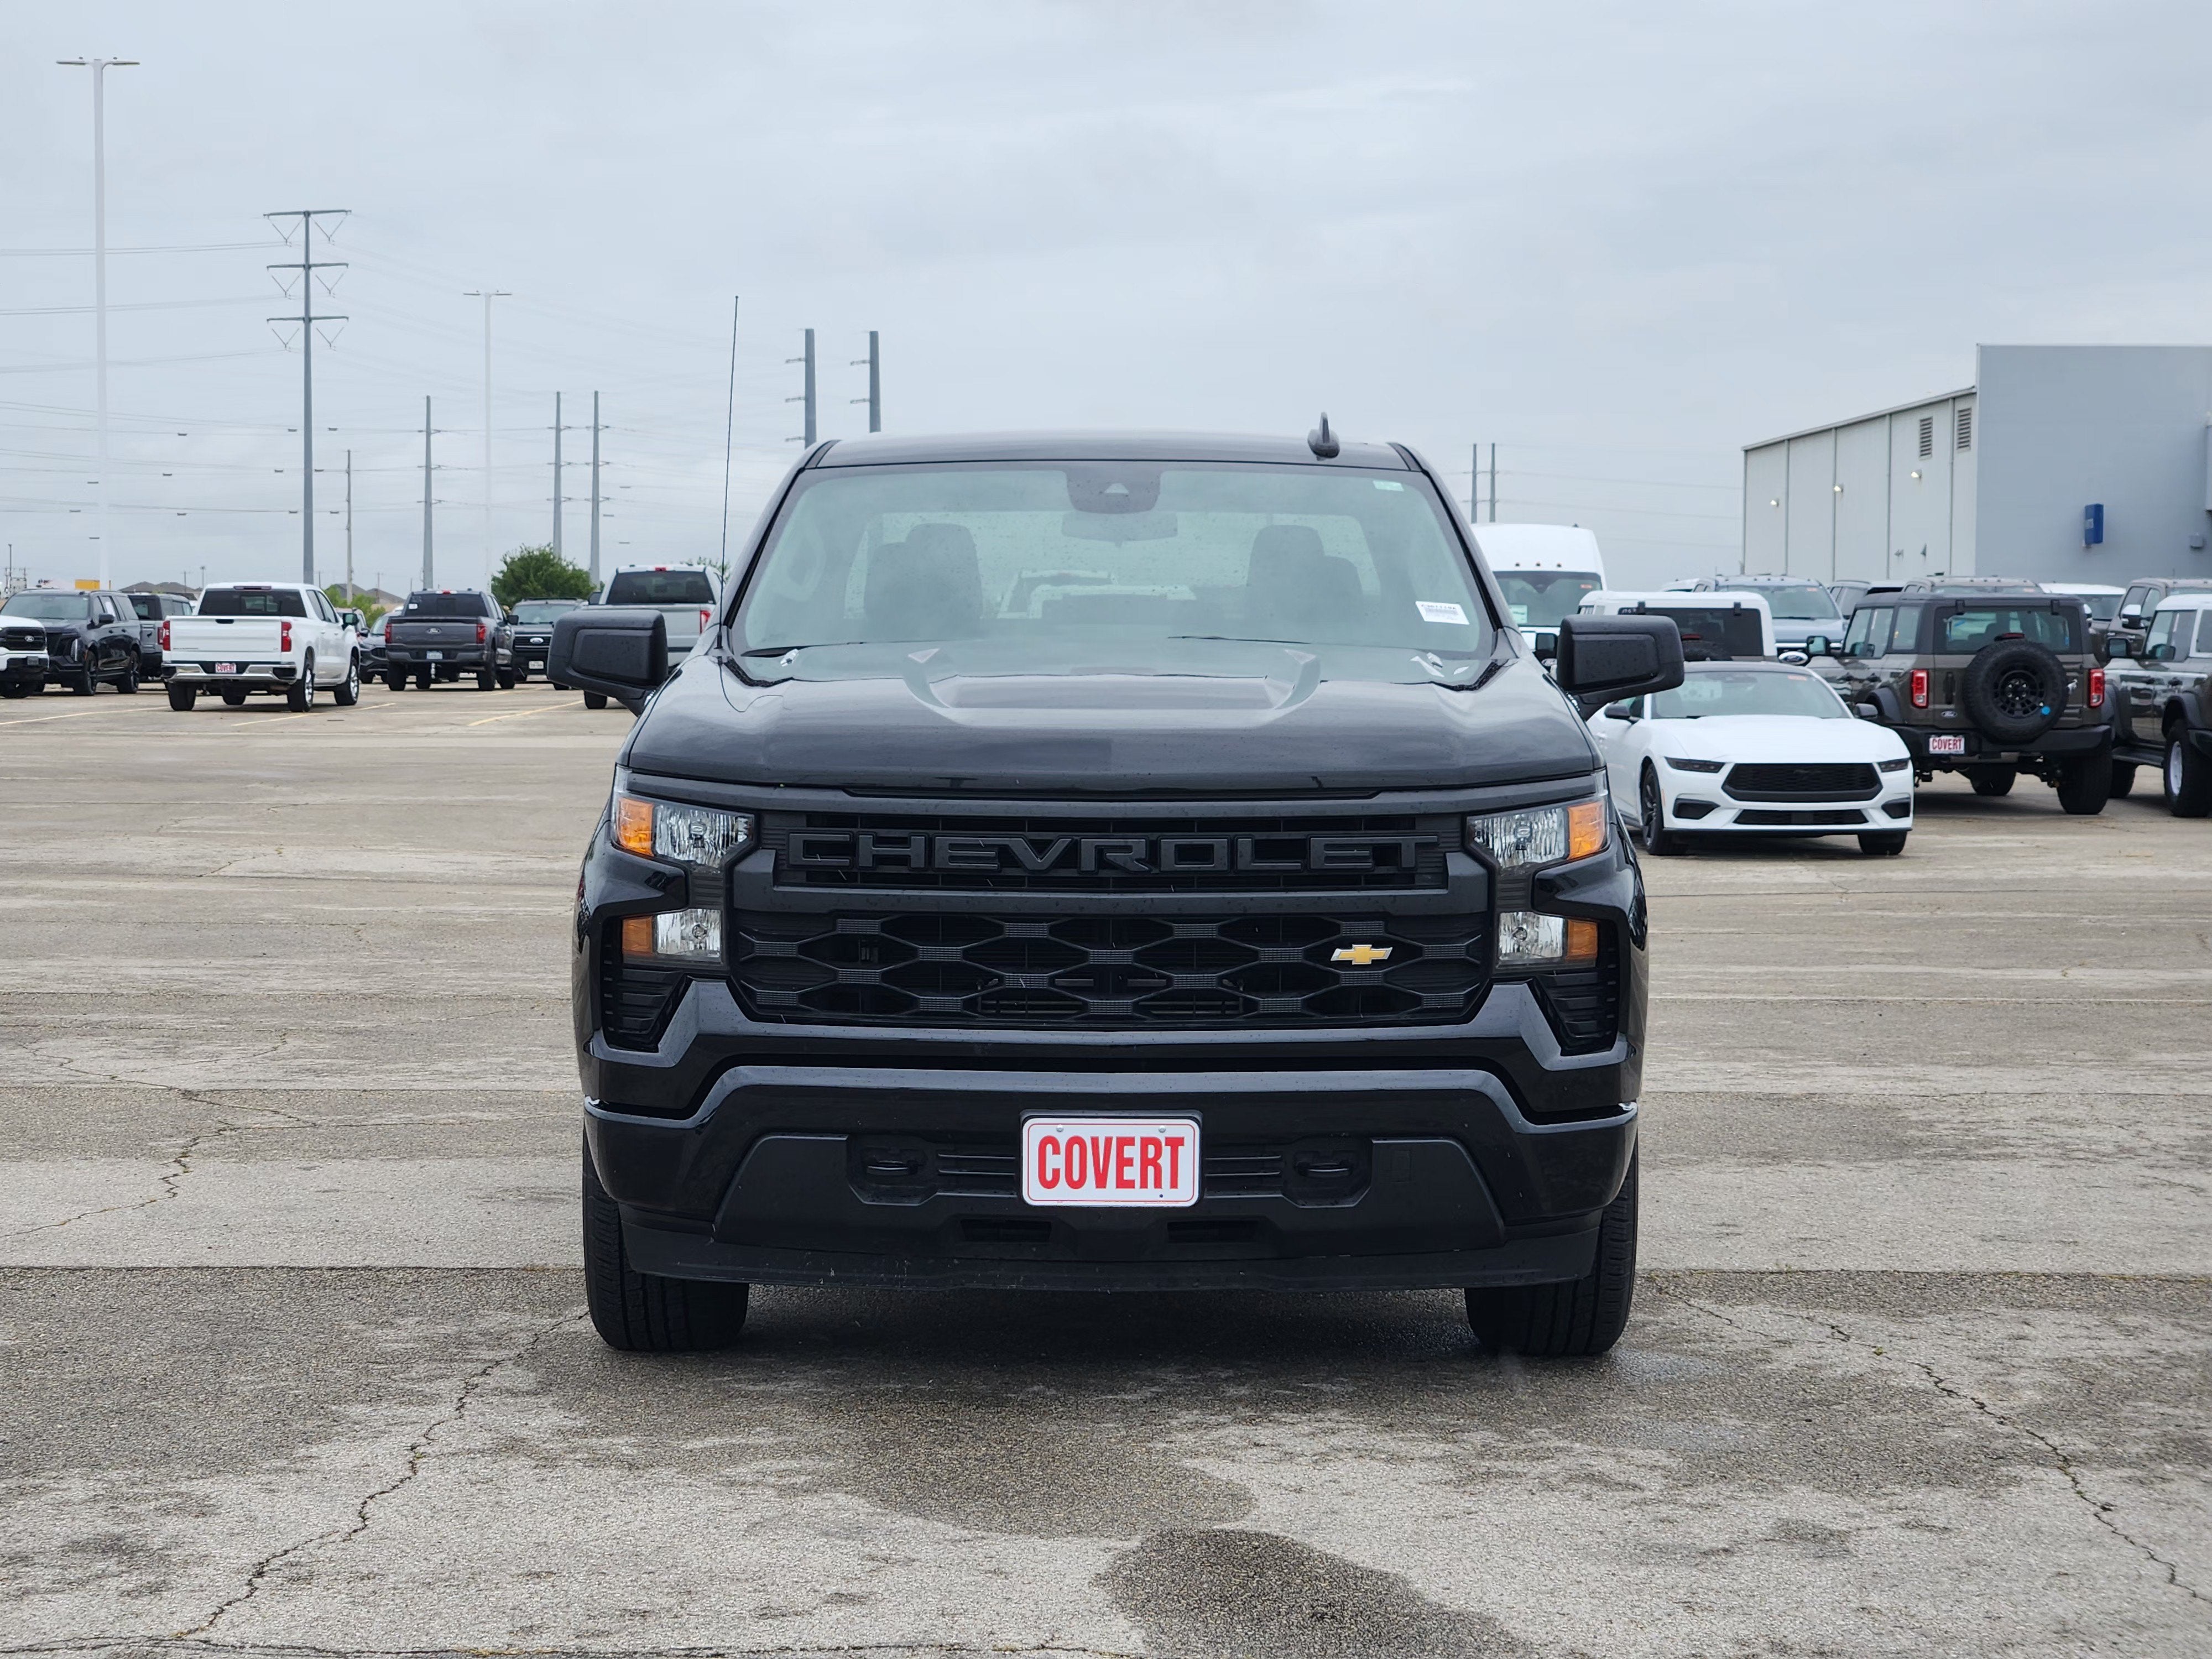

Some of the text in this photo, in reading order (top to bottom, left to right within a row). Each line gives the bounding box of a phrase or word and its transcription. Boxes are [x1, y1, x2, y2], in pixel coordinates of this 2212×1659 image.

[1932, 738, 1962, 750] COVERT
[789, 833, 1438, 872] CHEVROLET
[1038, 1135, 1185, 1189] COVERT
